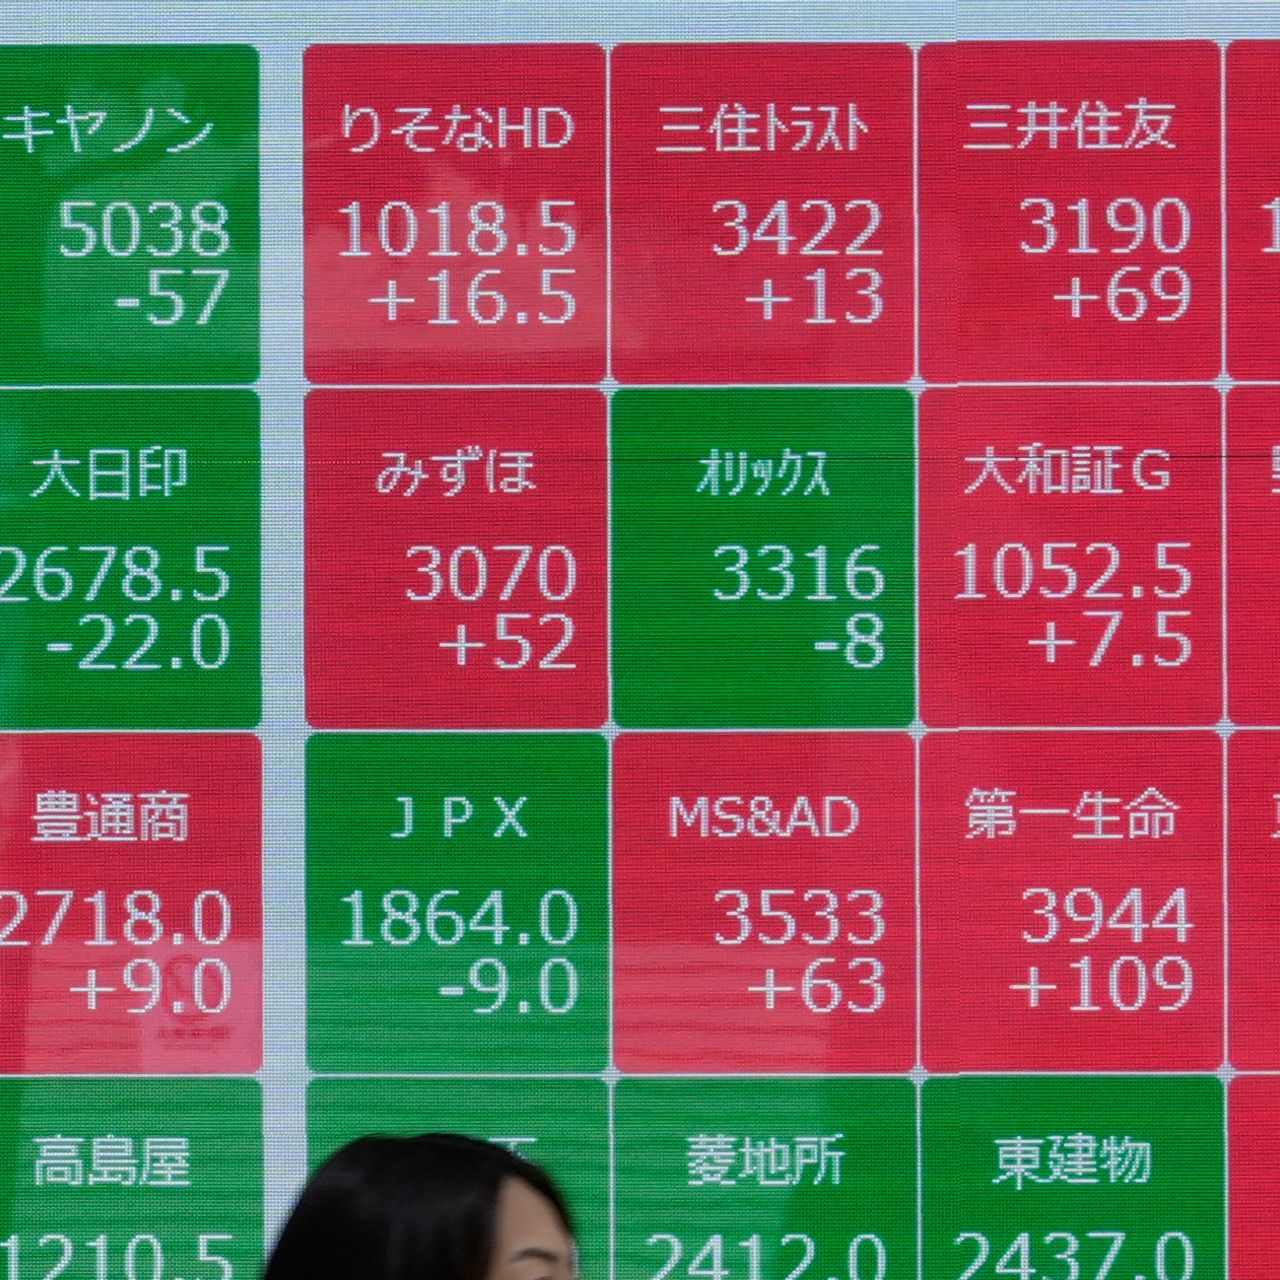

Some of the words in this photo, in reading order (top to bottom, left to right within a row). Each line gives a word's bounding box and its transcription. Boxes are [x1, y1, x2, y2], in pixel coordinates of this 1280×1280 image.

[3, 104, 212, 154] キヤノン
[342, 104, 575, 153] りそなHD
[964, 97, 1175, 150] 三井住友
[59, 199, 230, 258] 5038
[340, 199, 577, 258] 1018.5
[713, 199, 883, 257] 3422
[1020, 197, 1191, 254] 3190
[115, 267, 230, 326] -57
[369, 268, 576, 326] +16.5
[746, 267, 884, 325] +13
[1054, 265, 1191, 323] +69
[31, 444, 187, 500] 大日印
[376, 445, 535, 497] みずほ
[406, 544, 577, 602] 3070
[714, 544, 885, 601] 3316
[956, 542, 1192, 599] 1052.5
[47, 613, 230, 670] -22.0
[440, 612, 575, 670] +52
[815, 612, 885, 669] -8
[1029, 610, 1192, 668] +7.5
[32, 790, 188, 843] 豊通商
[669, 795, 860, 838] MS&AD
[965, 786, 1179, 840] 第一生命
[343, 889, 578, 947] 1864.0
[714, 888, 886, 946] 3533
[1023, 887, 1193, 944] 3944
[70, 956, 232, 1015] +9.0
[439, 956, 579, 1015] -9.0
[748, 956, 886, 1014] +63
[1011, 955, 1193, 1012] +109
[33, 1134, 191, 1187] 高島屋
[686, 1133, 844, 1188] 菱地所
[994, 1132, 1151, 1189] 東建物
